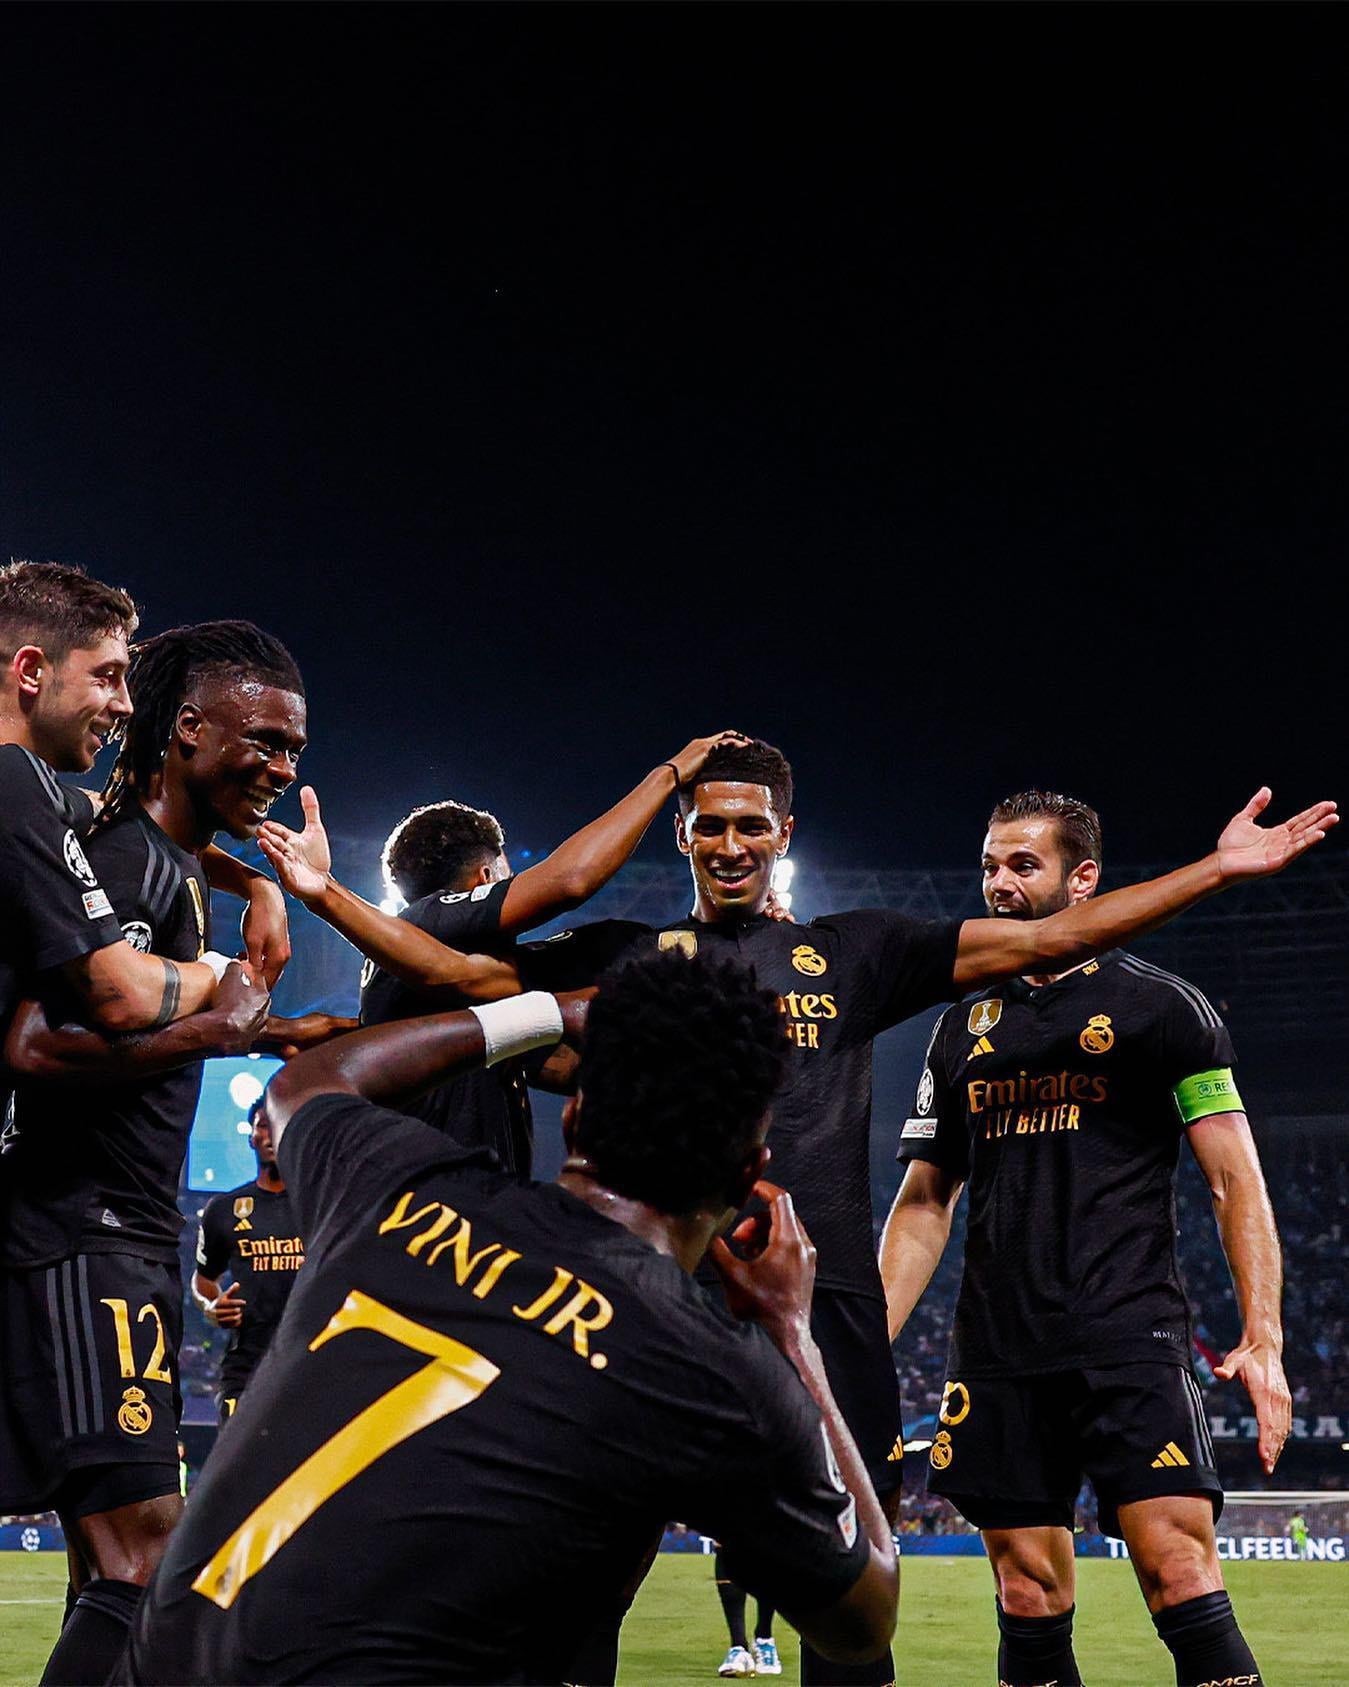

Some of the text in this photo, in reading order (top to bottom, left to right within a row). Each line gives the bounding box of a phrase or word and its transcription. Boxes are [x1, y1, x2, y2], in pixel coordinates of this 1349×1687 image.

[967, 1069, 1108, 1114] Emirates
[1016, 1104, 1080, 1135] BETTER
[237, 1236, 304, 1257] Emirat
[379, 1191, 614, 1370] VINI JR.
[100, 1298, 172, 1384] 12
[192, 1289, 501, 1610] 7
